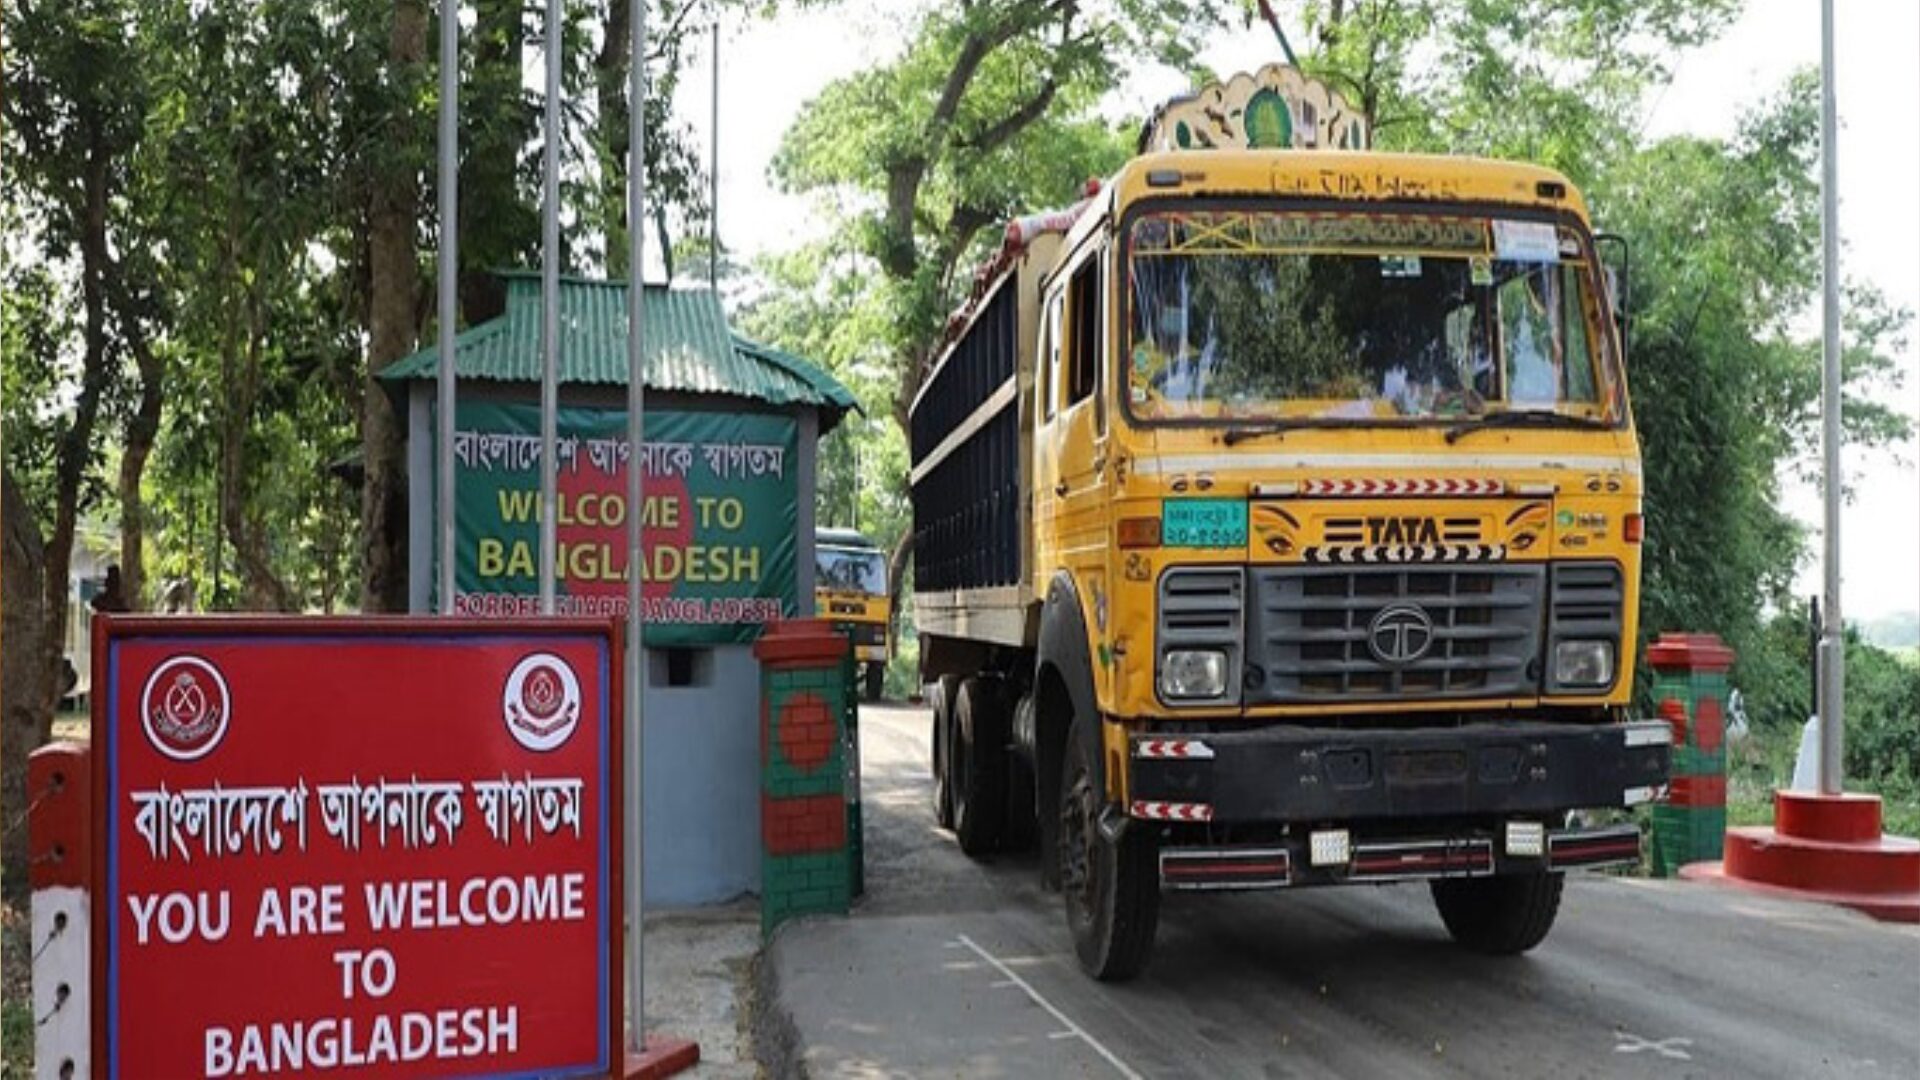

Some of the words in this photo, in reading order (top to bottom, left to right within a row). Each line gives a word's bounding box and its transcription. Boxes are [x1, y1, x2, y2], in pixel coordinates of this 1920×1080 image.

[701, 441, 784, 480] স্বাগতম
[697, 497, 744, 529] TO
[1367, 517, 1439, 545] TATA
[131, 778, 308, 861] বাংলাদেশে
[317, 774, 463, 850] আপনাকে
[472, 772, 584, 844] স্বাগতম
[127, 891, 231, 945] YOU
[254, 884, 346, 938] ARE
[364, 873, 586, 931] WELCOME
[333, 949, 396, 999] TO
[204, 1005, 518, 1078] BANGLADESH
